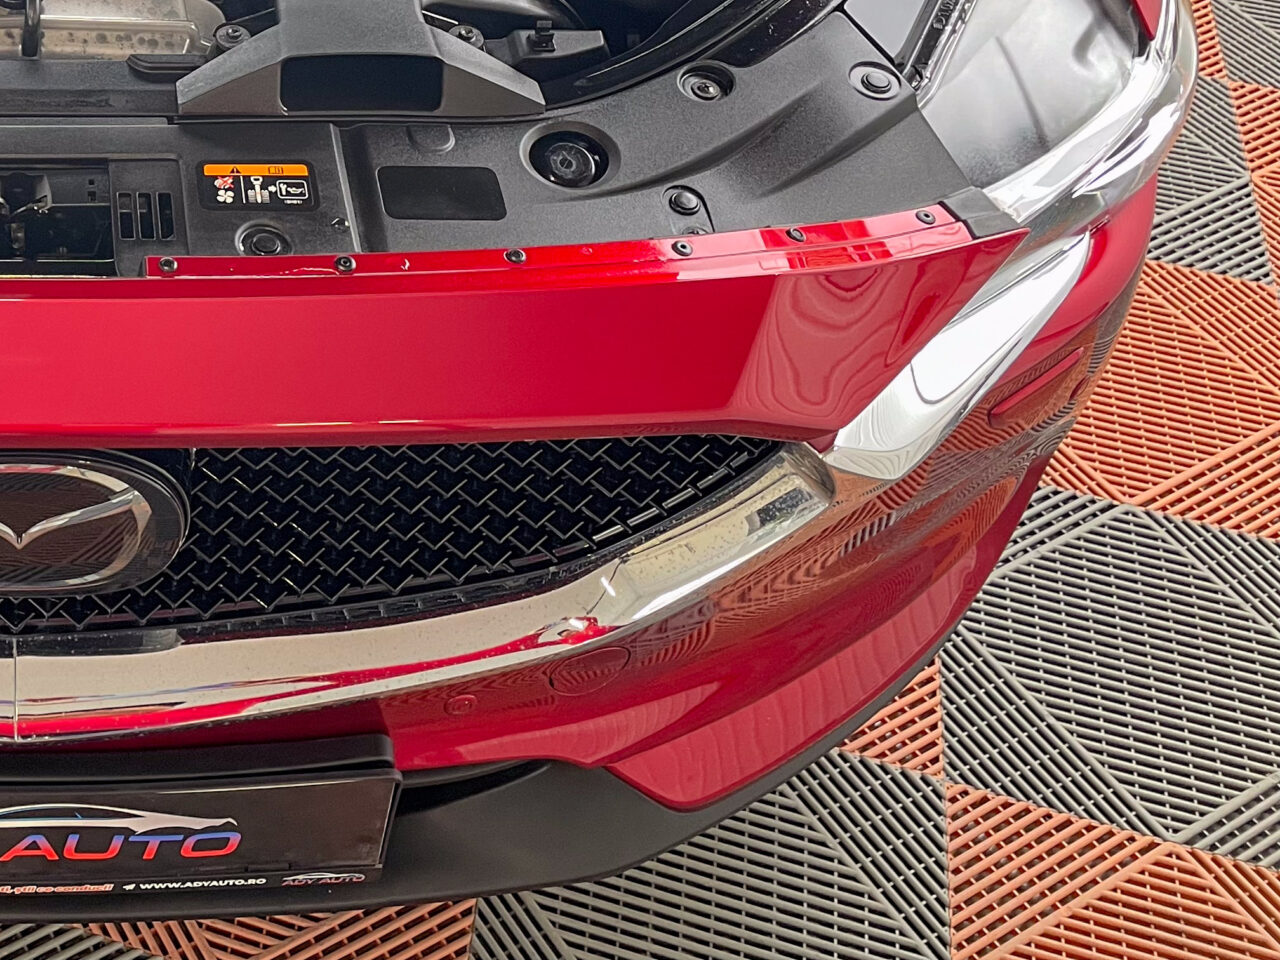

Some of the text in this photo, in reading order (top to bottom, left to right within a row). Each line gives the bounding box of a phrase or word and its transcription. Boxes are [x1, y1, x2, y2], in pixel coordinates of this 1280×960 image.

[139, 878, 267, 890] WWW.ADYAUTO.RO
[281, 874, 365, 886] ADY AUTO
